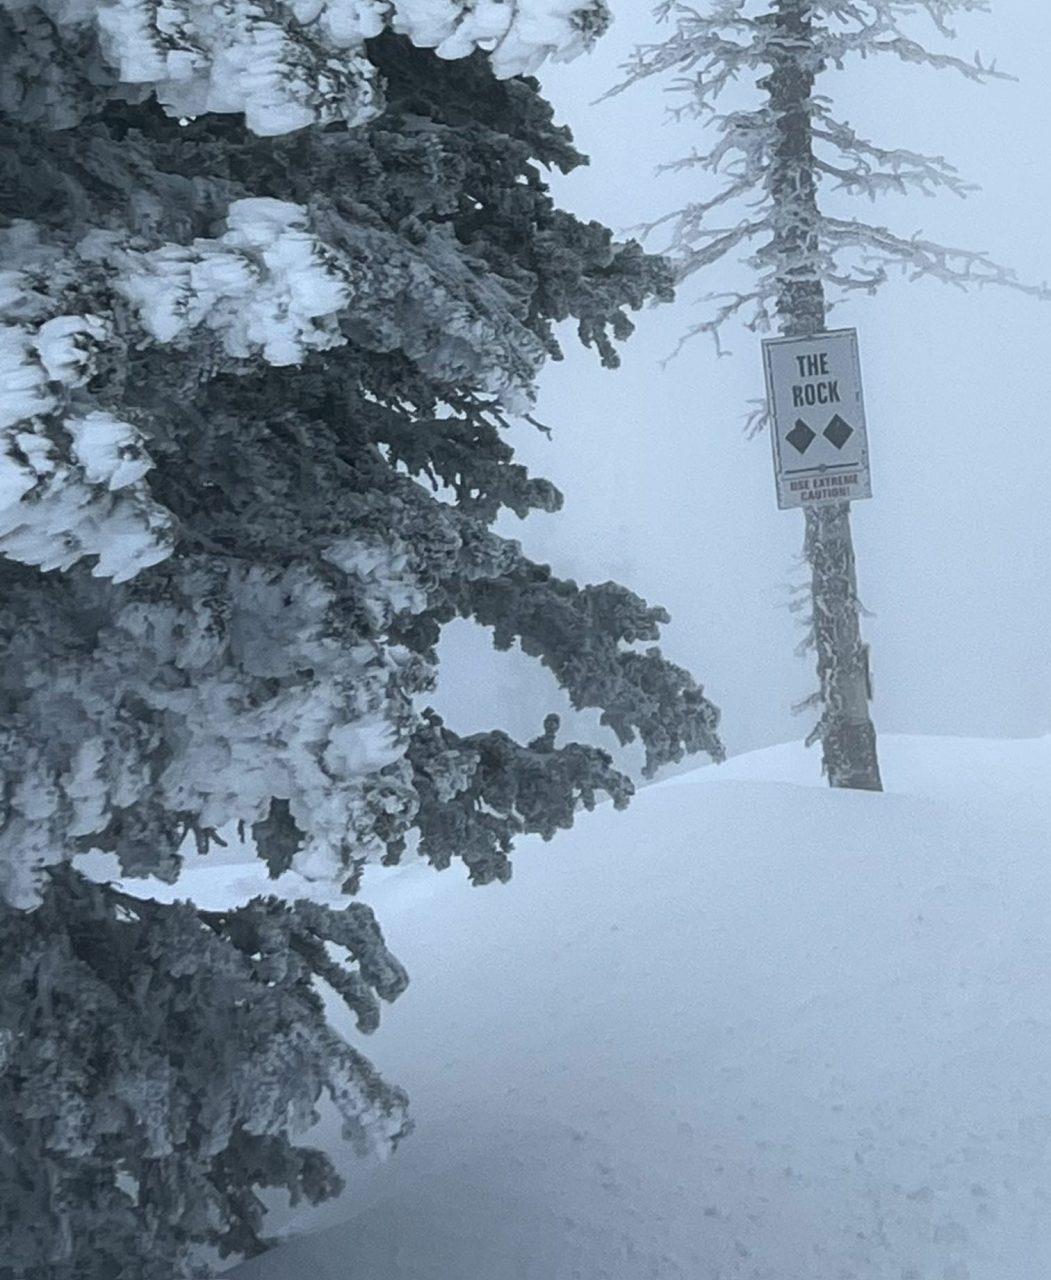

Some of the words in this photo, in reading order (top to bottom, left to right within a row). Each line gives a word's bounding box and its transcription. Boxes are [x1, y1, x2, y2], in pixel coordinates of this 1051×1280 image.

[796, 353, 830, 377] THE
[792, 381, 840, 407] ROCK
[790, 479, 810, 491] USE
[814, 474, 858, 489] EXTREME
[801, 486, 851, 501] CAUTION!
